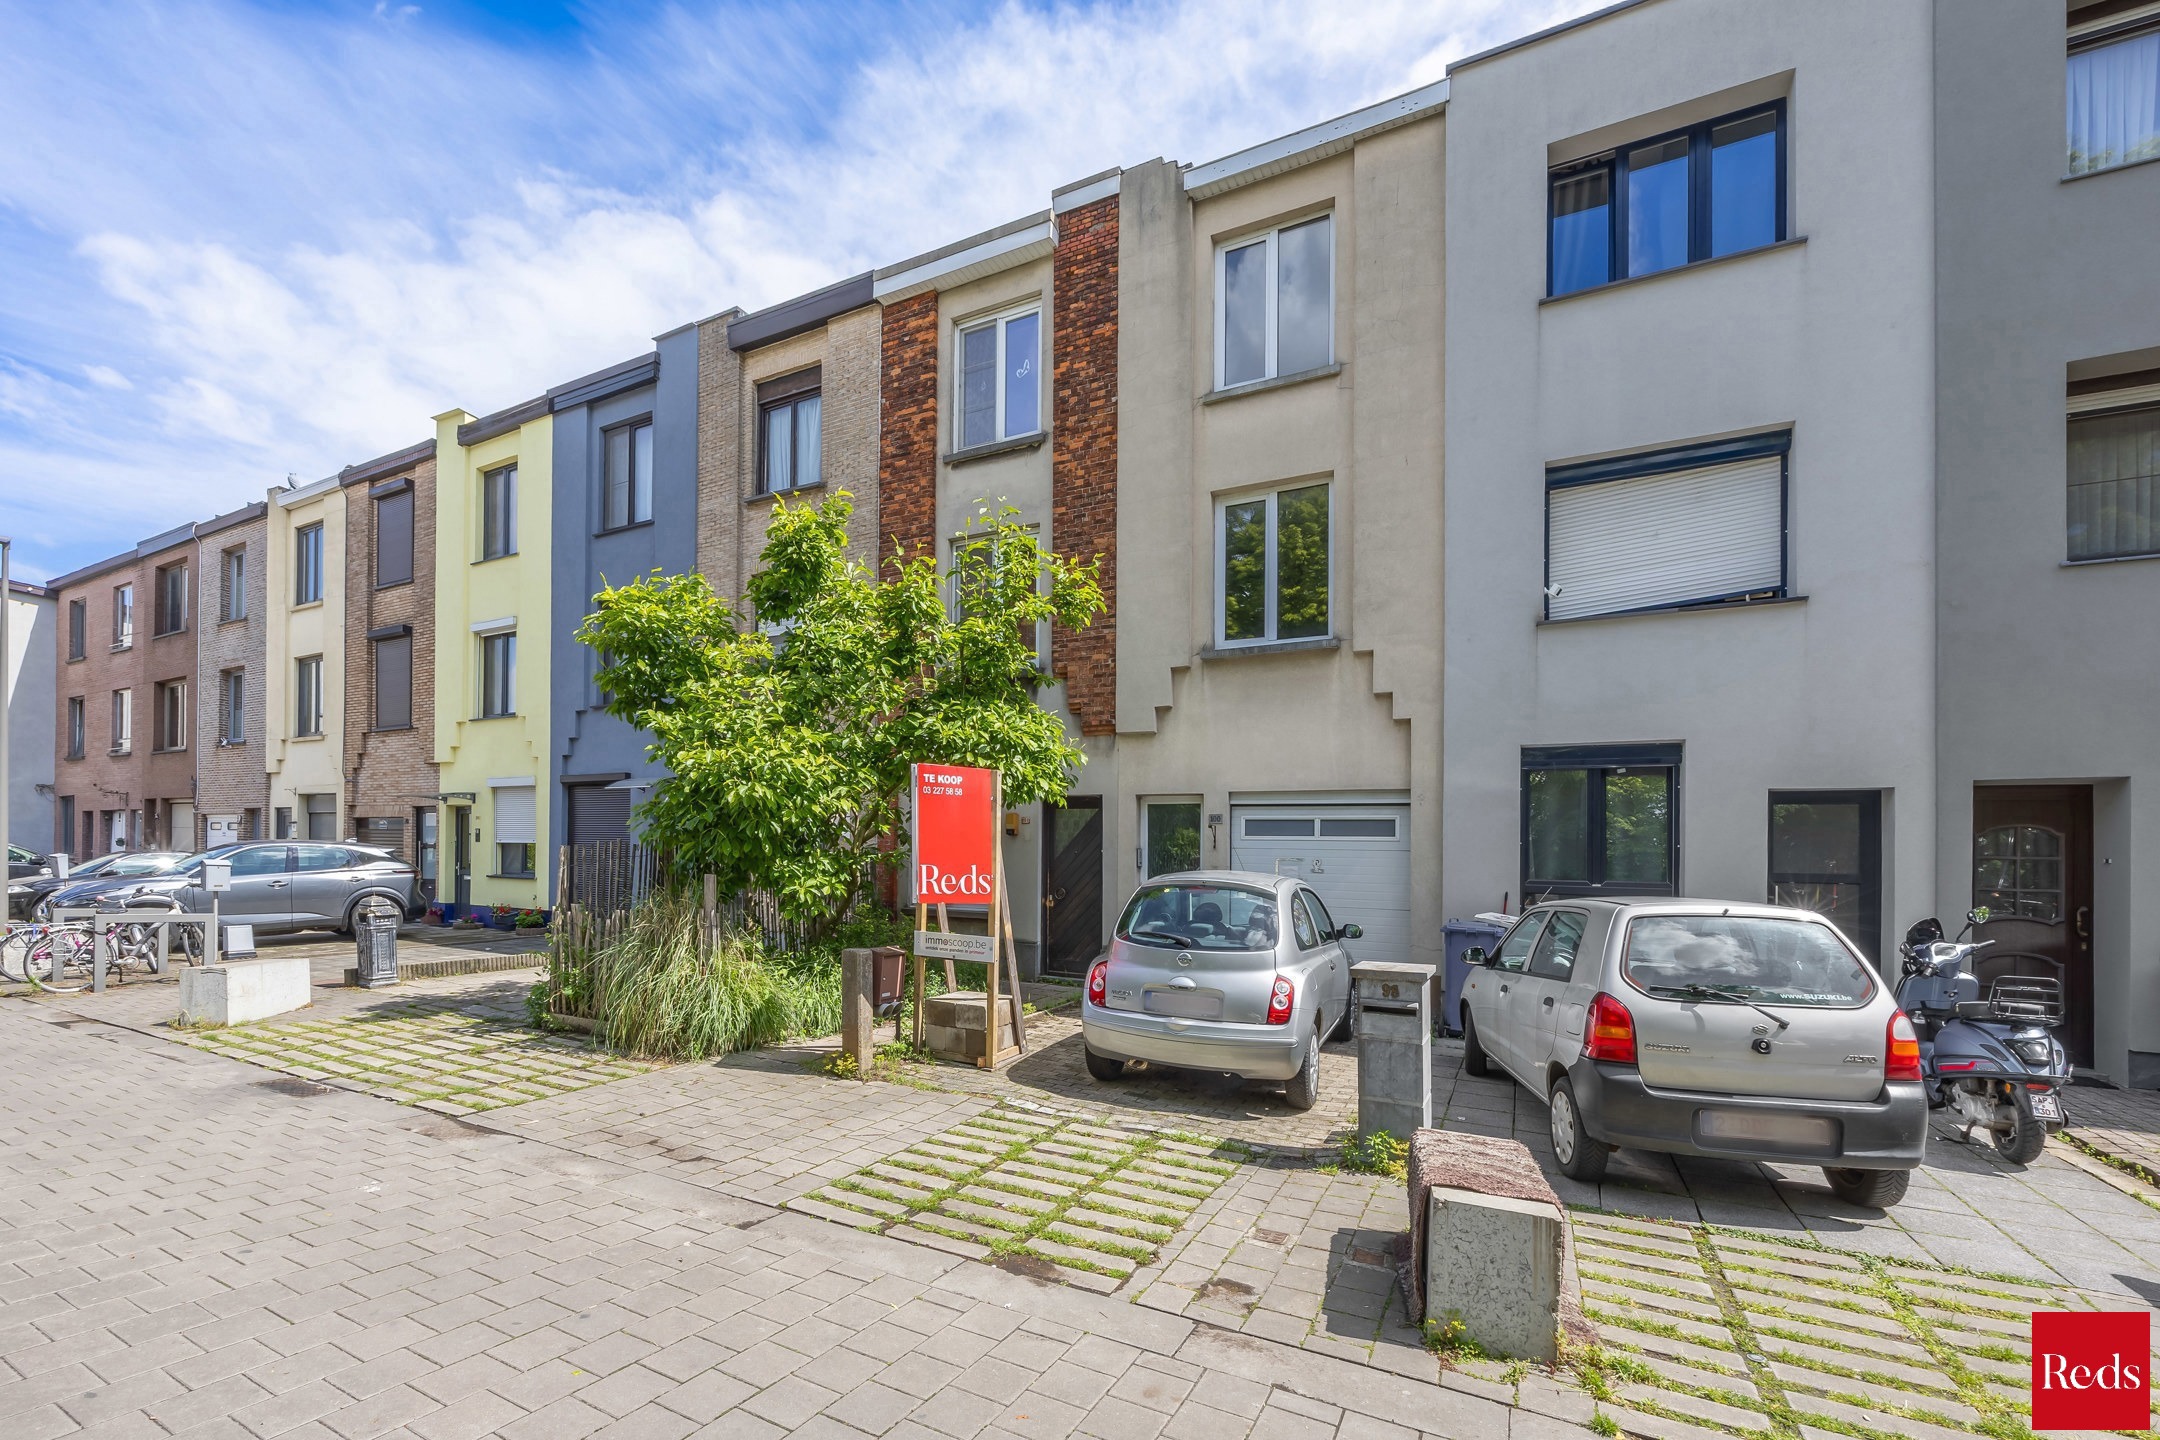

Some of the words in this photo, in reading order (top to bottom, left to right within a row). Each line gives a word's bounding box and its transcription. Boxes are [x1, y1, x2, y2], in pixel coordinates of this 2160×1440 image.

[923, 773, 936, 783] TE
[937, 774, 963, 785] KOOP
[922, 785, 931, 794] 03
[932, 786, 945, 795] 227
[945, 787, 954, 795] 58
[954, 787, 963, 796] 58
[919, 864, 991, 895] Reds
[925, 935, 986, 949] immoscoop.be
[1779, 993, 1853, 1001] www.SUZUKI.be
